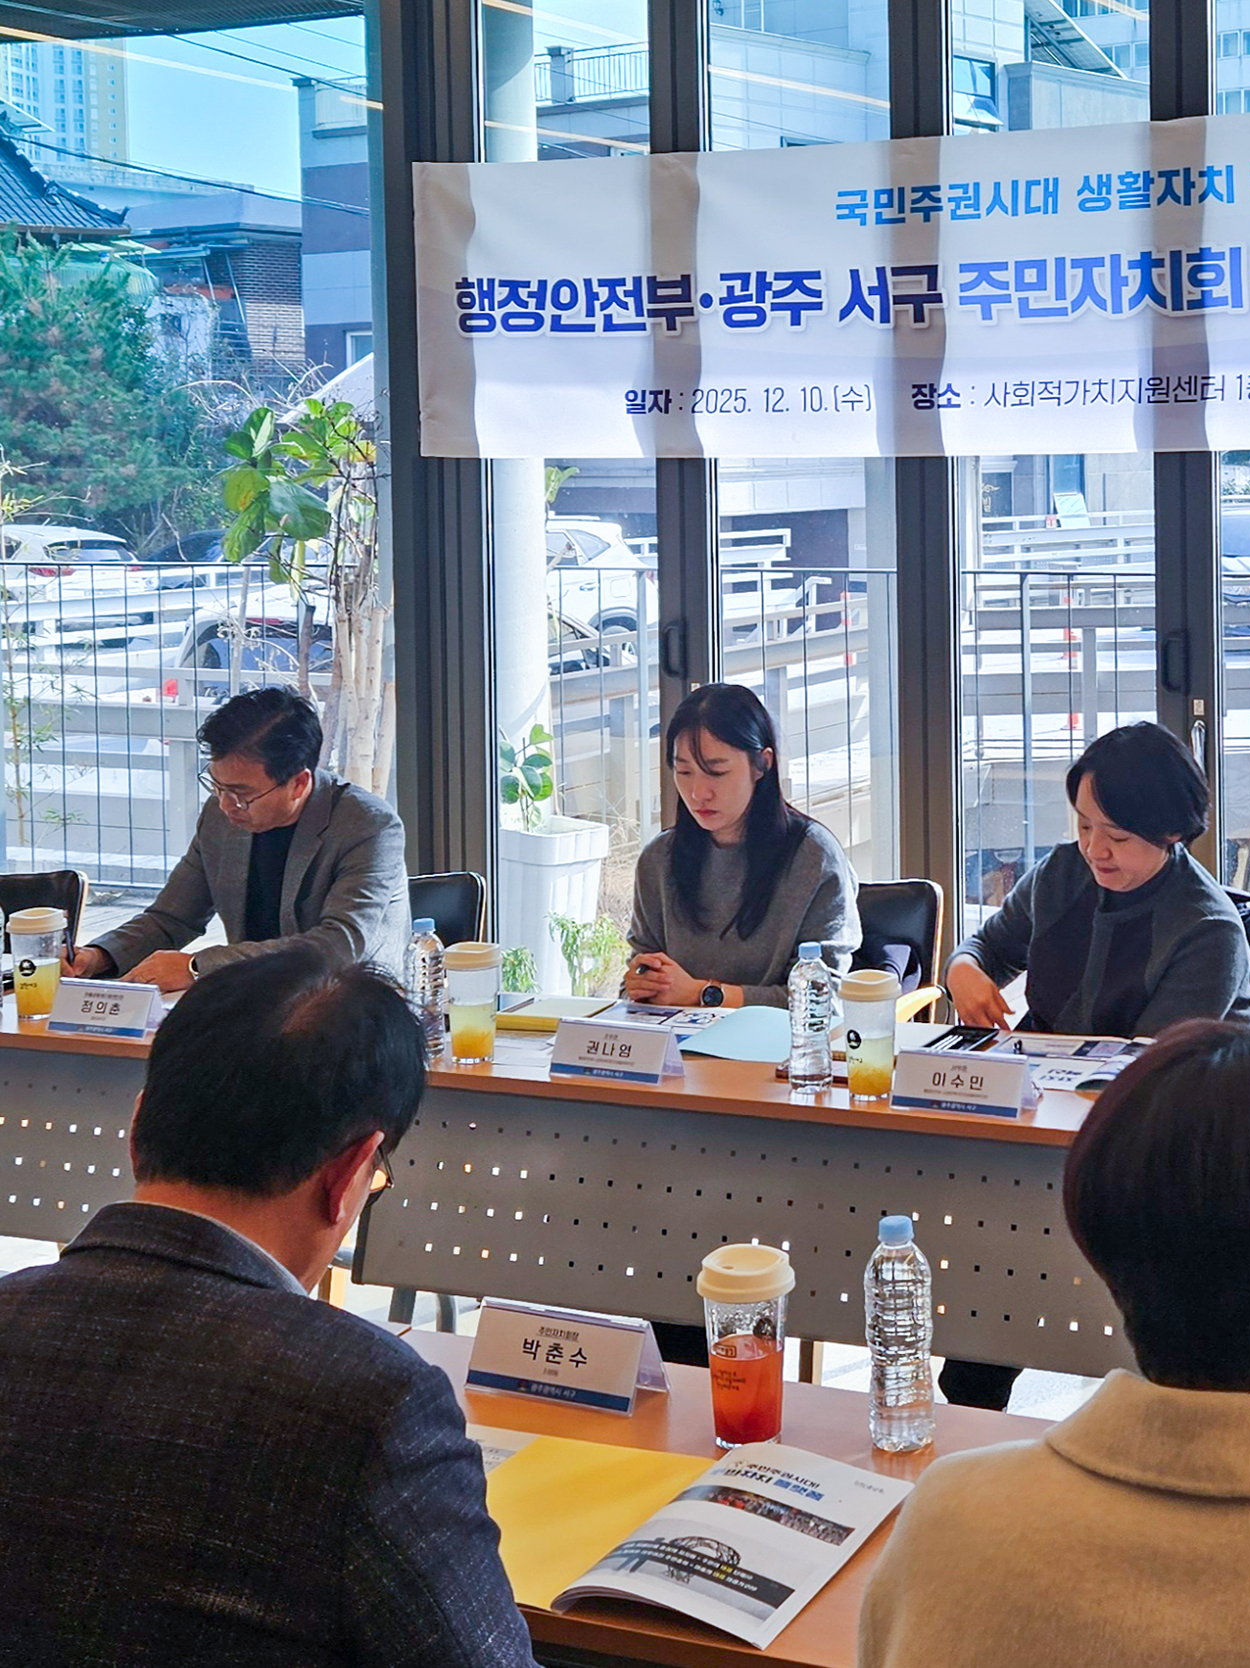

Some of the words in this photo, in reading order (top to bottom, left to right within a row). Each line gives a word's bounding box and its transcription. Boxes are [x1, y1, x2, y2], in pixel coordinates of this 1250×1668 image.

[835, 176, 1059, 226] 국민주권시대
[1077, 164, 1235, 215] 생활자치
[839, 264, 943, 326] 서구
[959, 246, 1243, 322] 주민자치회
[625, 388, 672, 415] 일자
[692, 388, 752, 414] 2025.
[763, 387, 790, 413] 12.
[911, 382, 962, 410] 장소
[984, 372, 1226, 410] 사회적가치지원센터
[932, 1072, 984, 1091] 이수민
[522, 1338, 587, 1368] 박춘수
